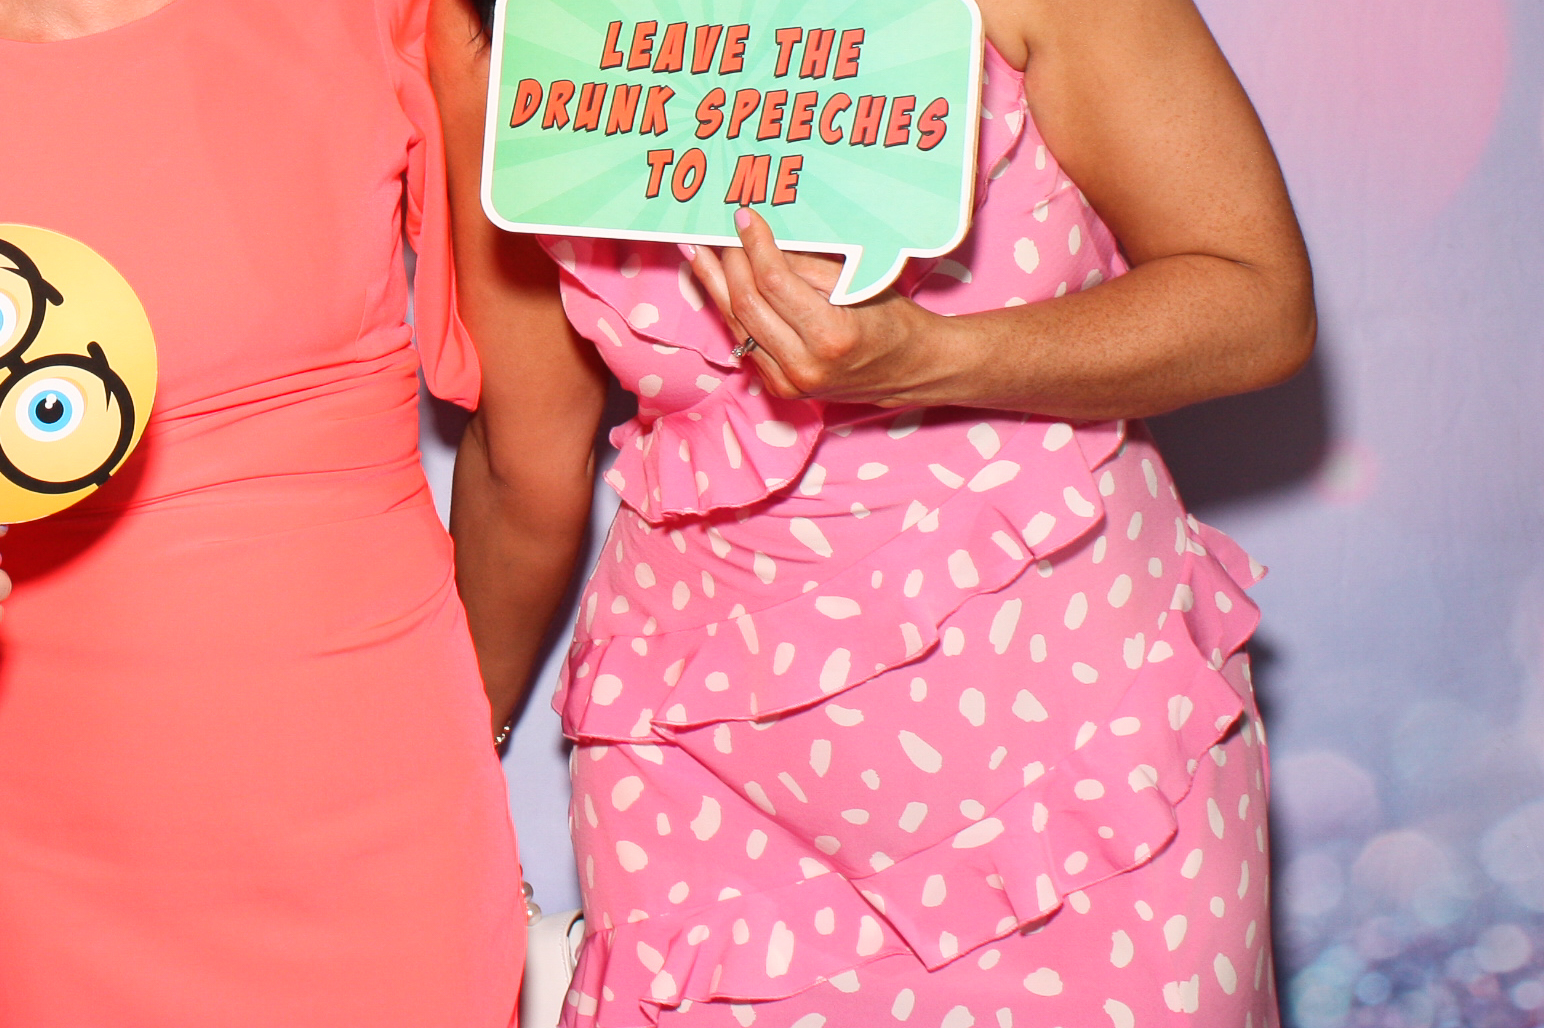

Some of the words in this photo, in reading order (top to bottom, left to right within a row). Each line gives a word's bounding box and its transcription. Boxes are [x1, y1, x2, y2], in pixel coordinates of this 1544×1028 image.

[600, 20, 749, 75] LEAVE
[774, 26, 865, 80] THE
[509, 78, 675, 135] DRUNK
[695, 87, 949, 151] SPEECHES
[645, 148, 707, 203] TO
[724, 154, 804, 207] ME
